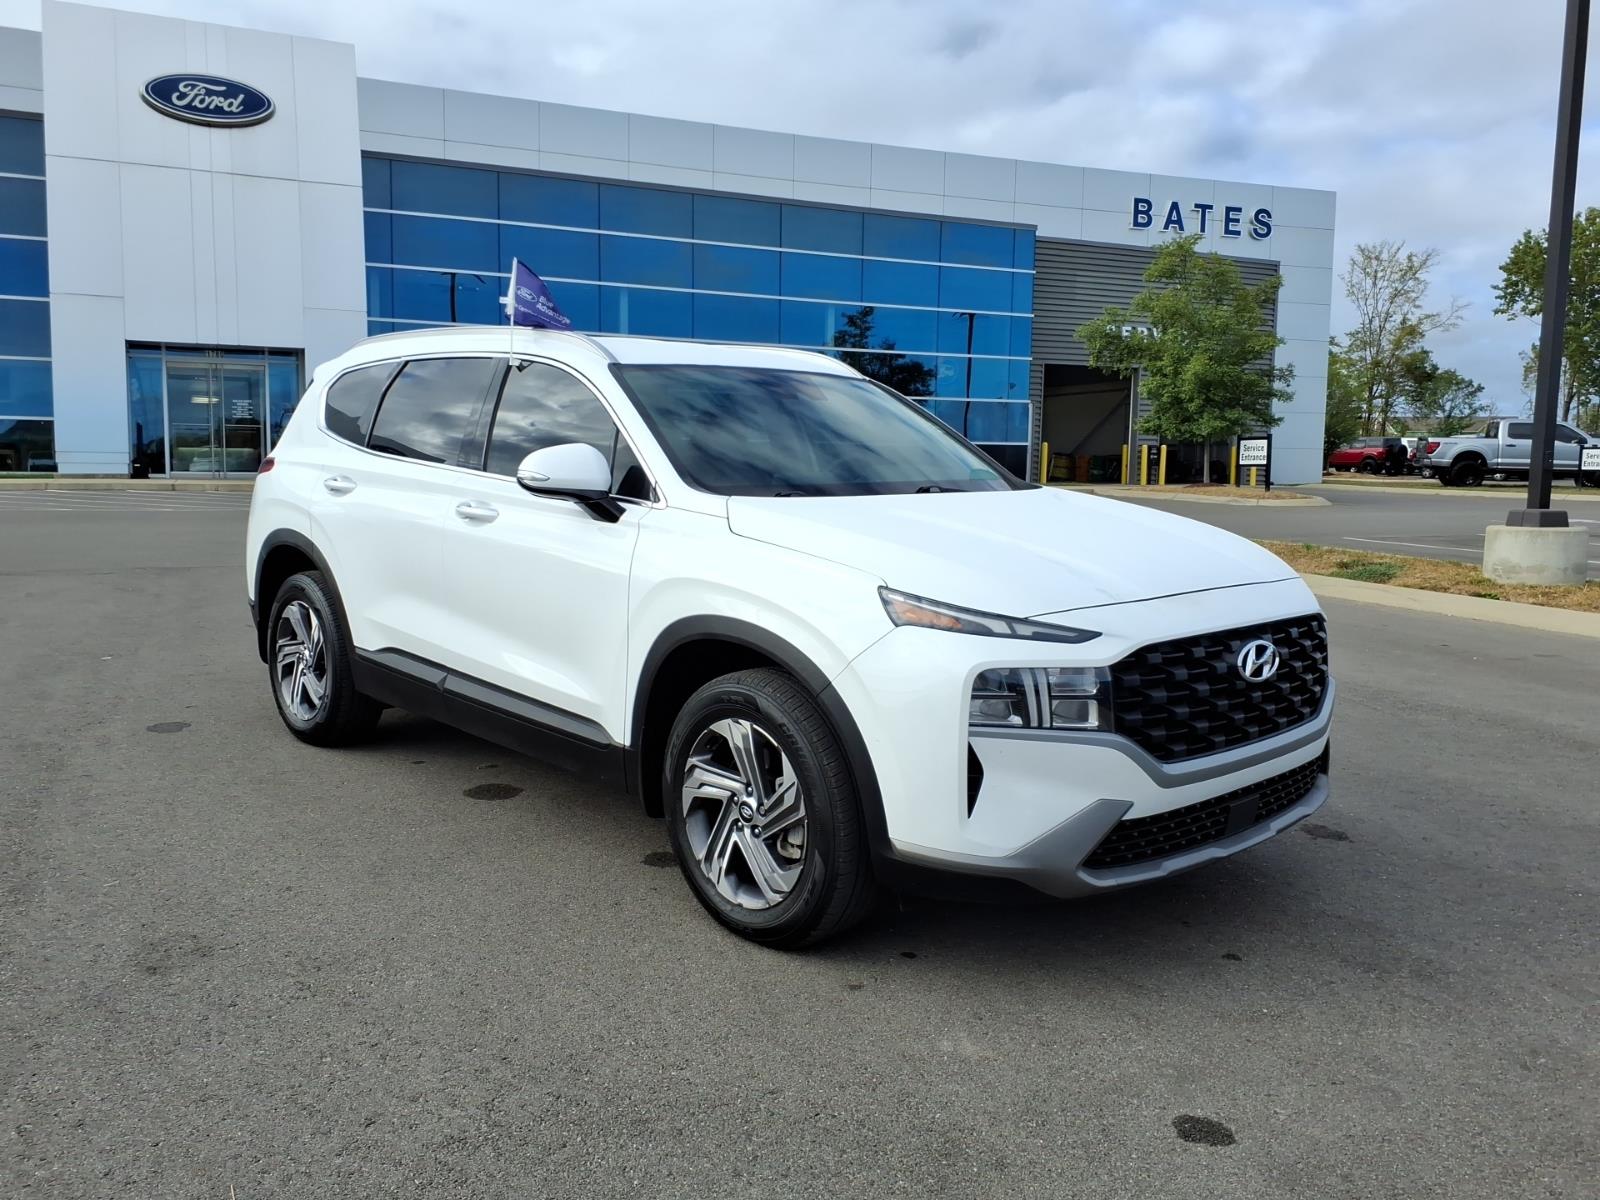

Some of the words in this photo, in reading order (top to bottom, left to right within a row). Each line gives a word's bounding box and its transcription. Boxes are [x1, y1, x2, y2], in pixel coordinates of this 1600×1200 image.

[171, 80, 245, 113] Ford
[1131, 197, 1273, 240] BATES
[539, 295, 554, 308] Blue
[1243, 444, 1265, 452] Service
[1241, 453, 1267, 461] Entrance
